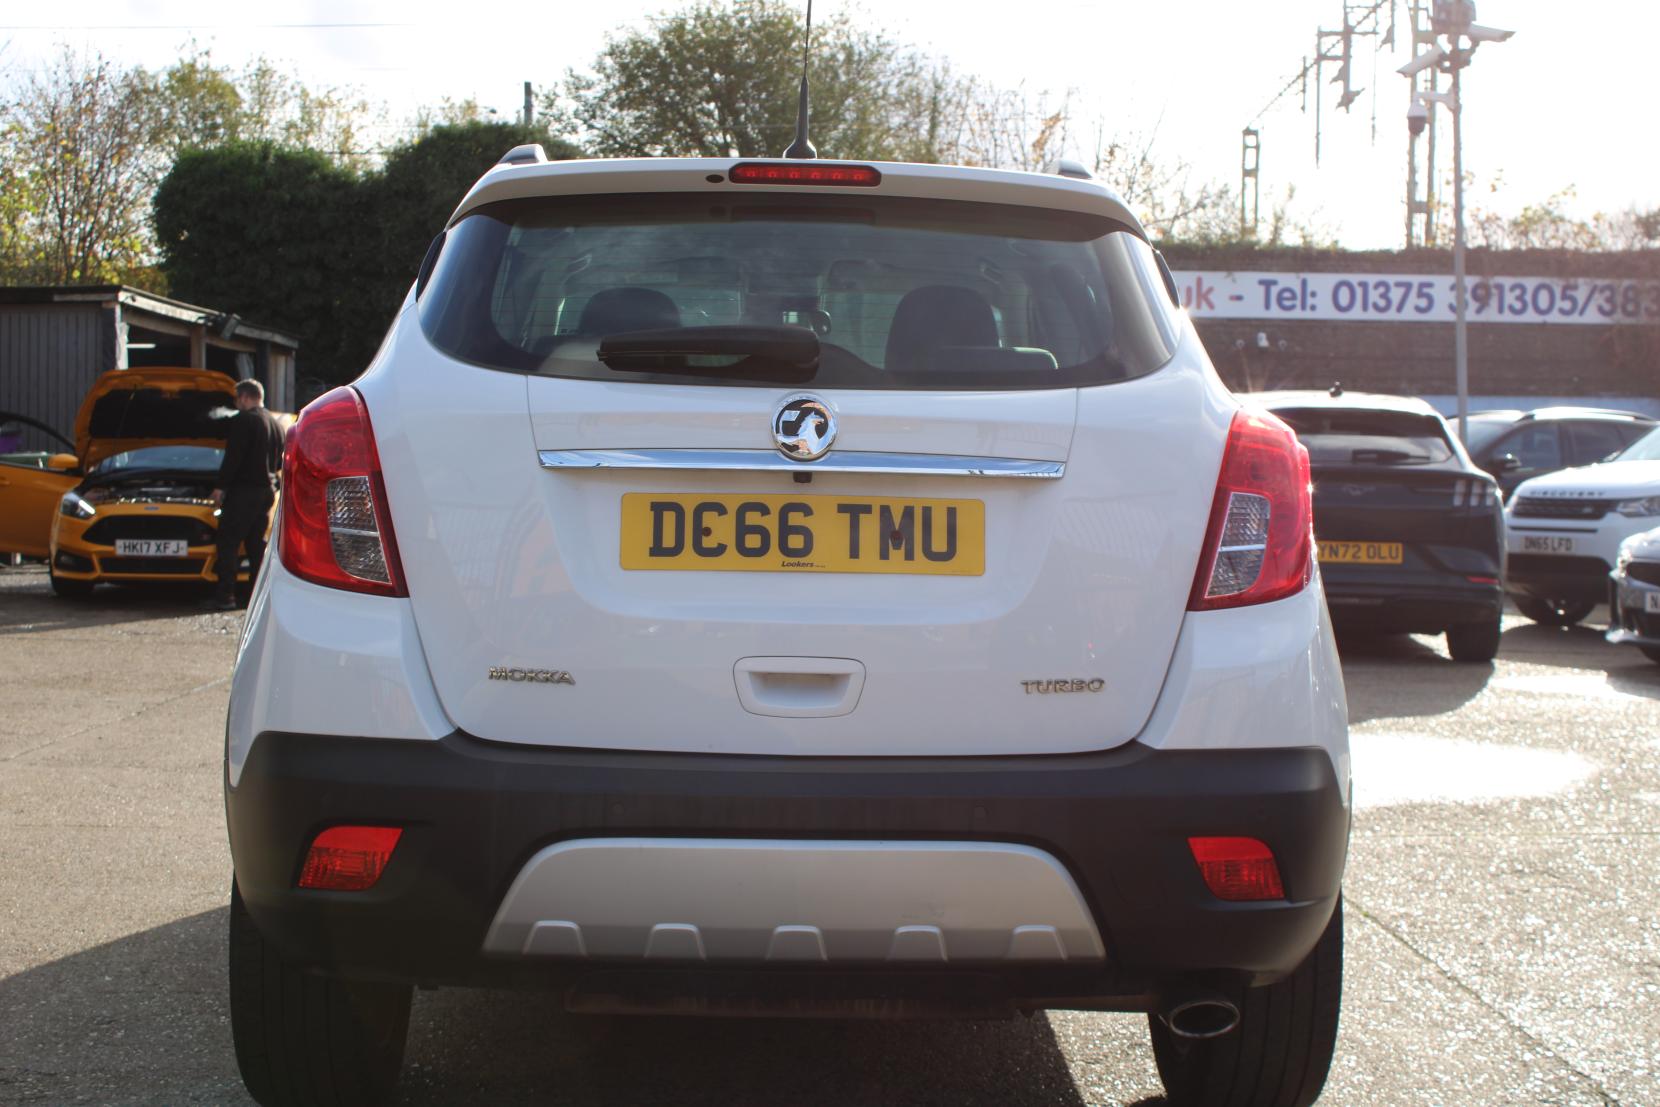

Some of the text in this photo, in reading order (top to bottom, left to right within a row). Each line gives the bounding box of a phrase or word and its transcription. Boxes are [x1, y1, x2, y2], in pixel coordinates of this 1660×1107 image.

[1258, 278, 1317, 312] Tel:
[1332, 279, 1435, 314] 01375
[837, 503, 957, 562] TMU
[123, 541, 151, 553] HK17
[1320, 543, 1362, 560] YN72
[488, 667, 575, 686] MOKKA
[1020, 679, 1105, 694] TURBO
